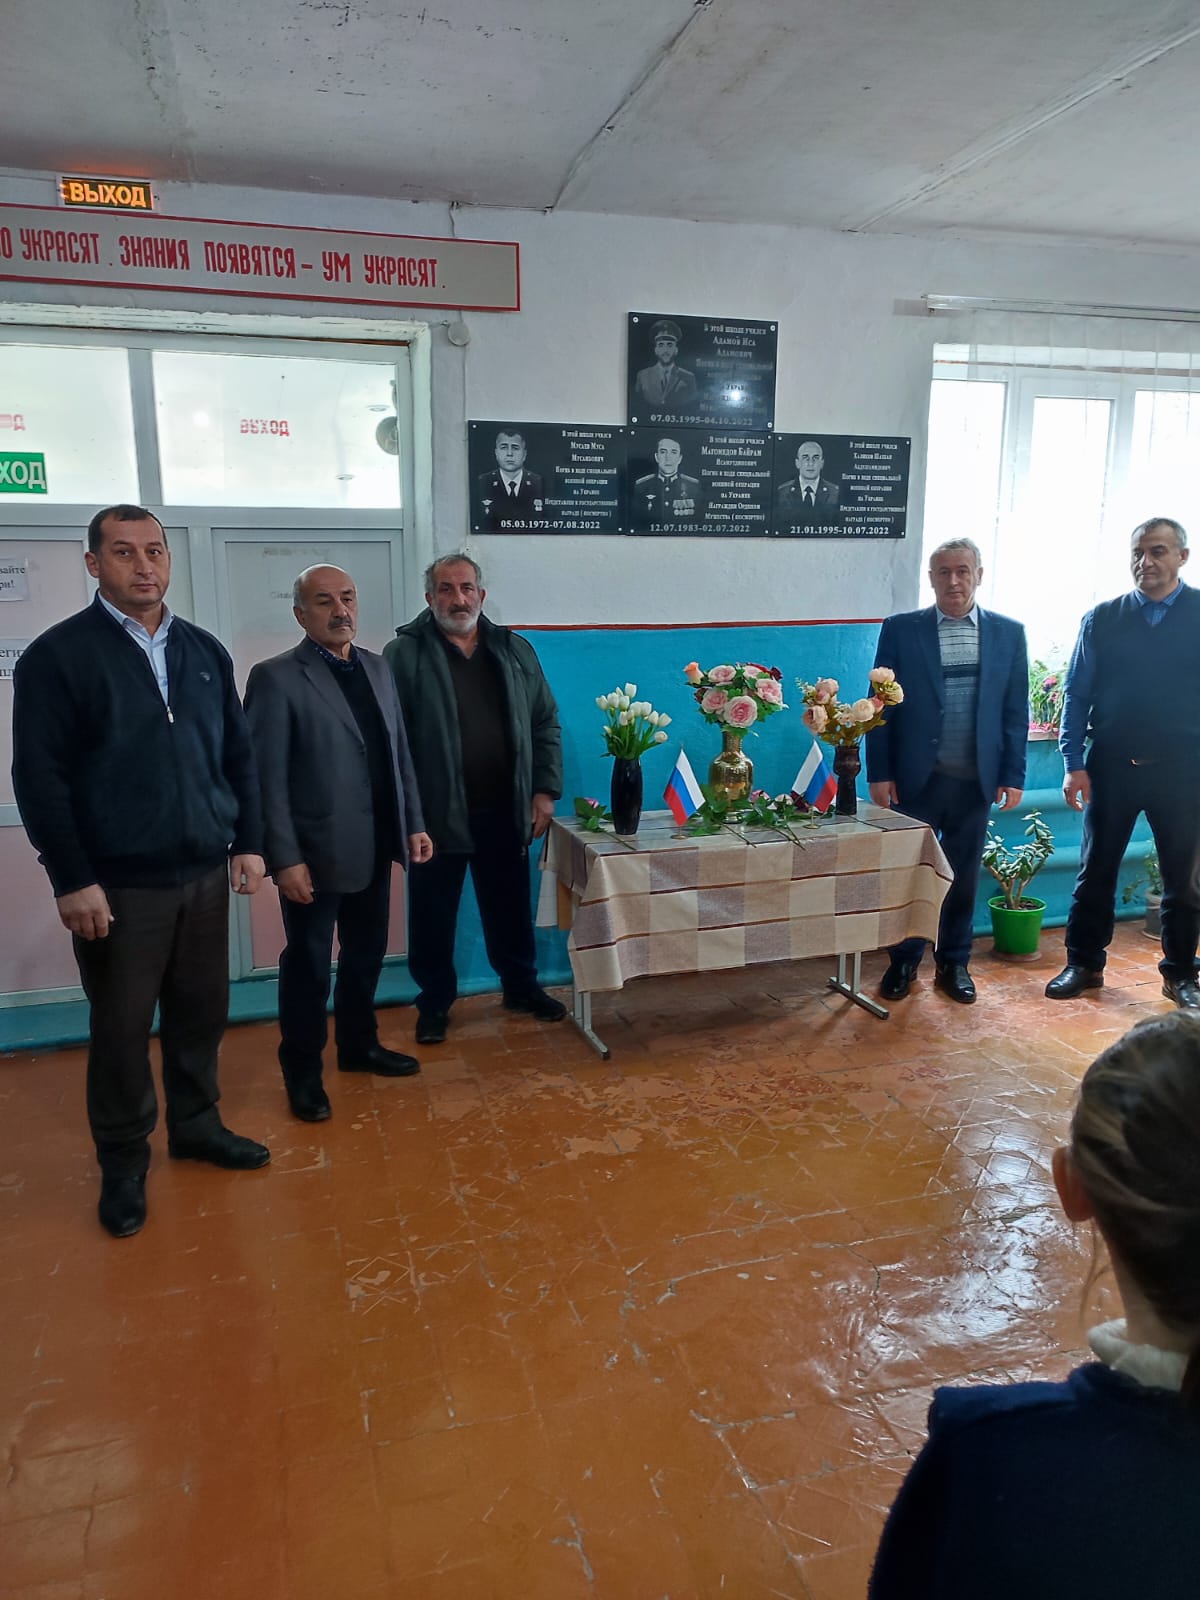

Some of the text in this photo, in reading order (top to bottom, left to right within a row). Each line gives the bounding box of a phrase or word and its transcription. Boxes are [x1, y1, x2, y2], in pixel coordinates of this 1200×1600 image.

[69, 182, 147, 207] ВЫХОД
[119, 235, 190, 270] ЗНАНИЯ
[204, 241, 296, 279] ПОЯВЯТСЯ
[322, 251, 352, 282] УМ
[651, 414, 752, 425] 07.03.1995-04.10.2022
[500, 520, 600, 529] 05.03.1972-07.08.2022
[650, 524, 750, 532] 12.07.1983-02.07.2022
[790, 526, 889, 535] 21.01.1995-10.07.2022
